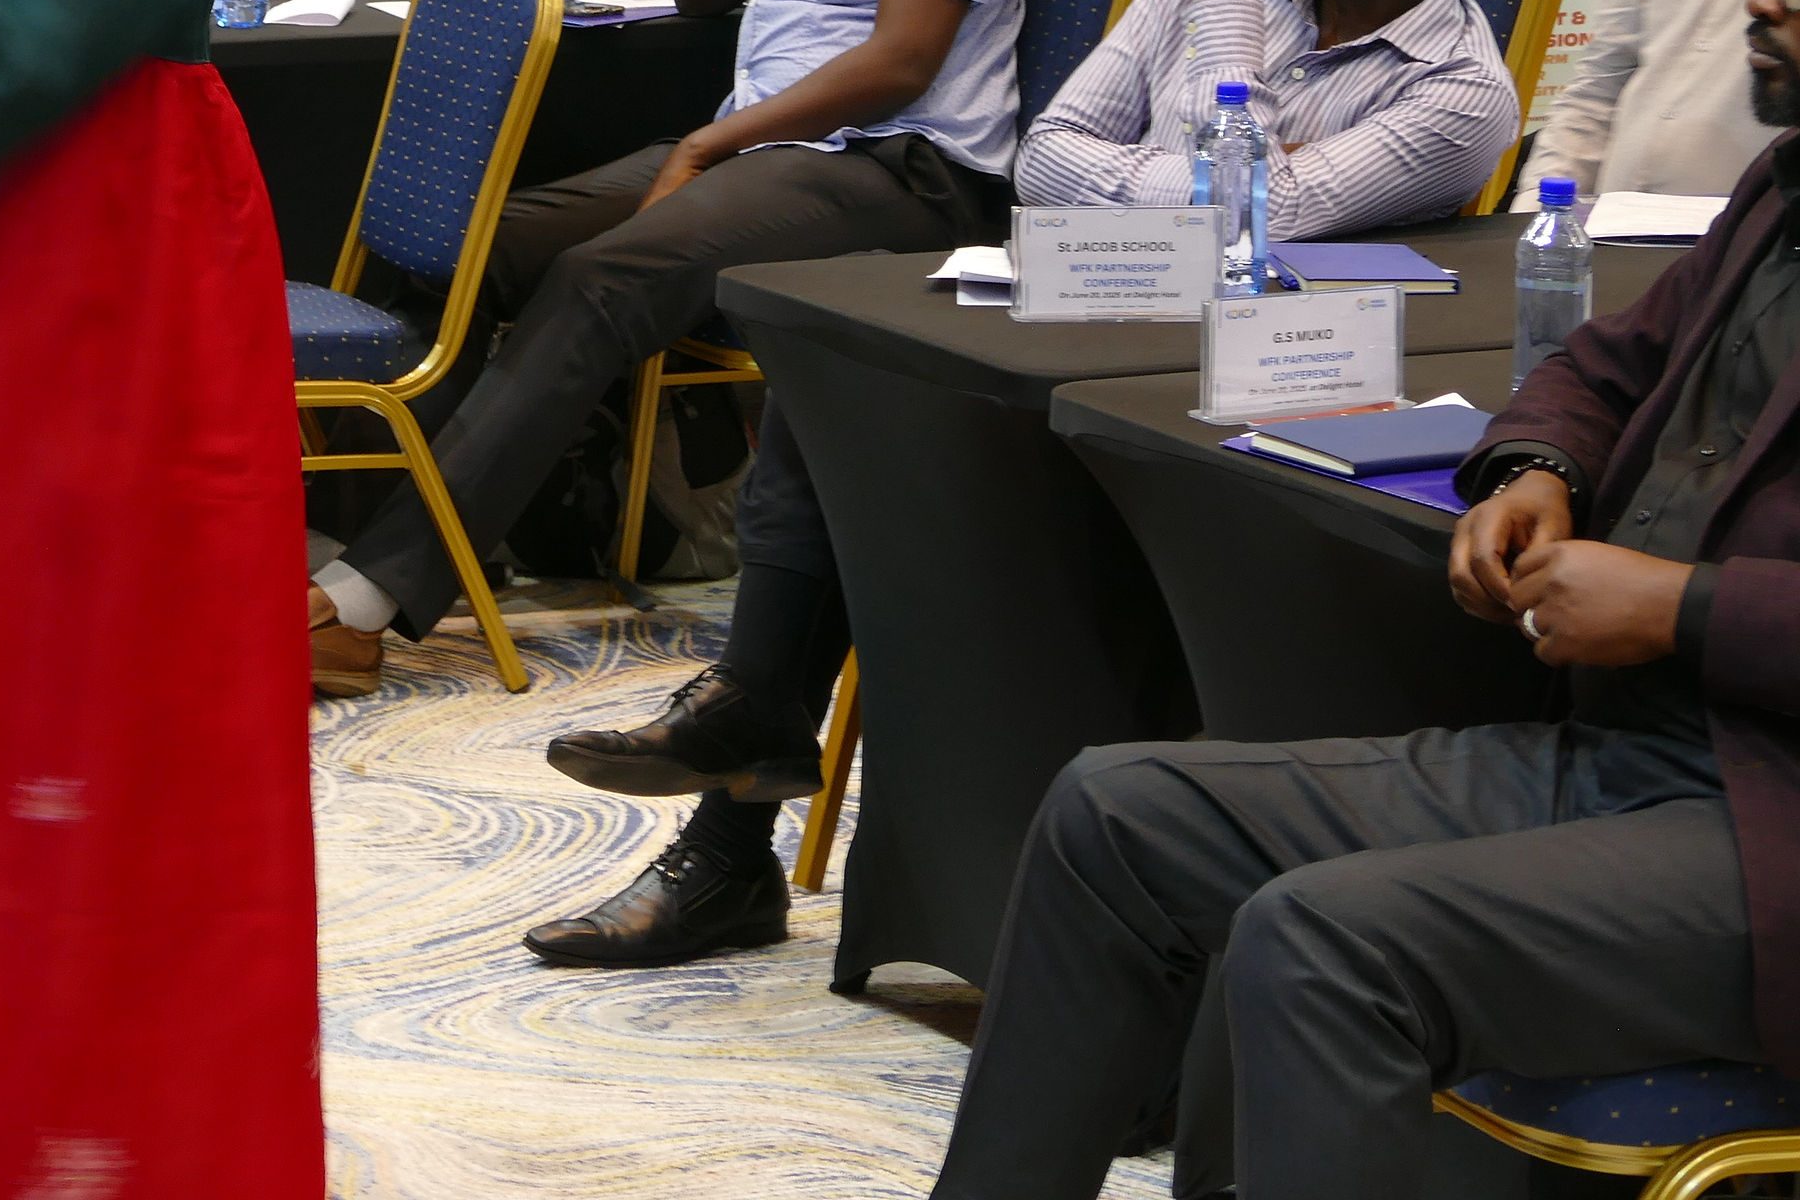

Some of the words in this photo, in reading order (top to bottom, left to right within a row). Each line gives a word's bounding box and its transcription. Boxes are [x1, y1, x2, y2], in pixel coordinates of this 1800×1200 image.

[1572, 11, 1587, 25] &
[1547, 33, 1594, 48] SION
[1057, 242, 1072, 253] St
[1075, 242, 1118, 253] JACOB
[1121, 241, 1176, 252] SCHOOL
[1069, 263, 1093, 273] WFK
[1095, 263, 1171, 273] PARTNERSHIP
[1083, 278, 1158, 288] CONFERENCE
[1272, 331, 1293, 344] G.S
[1295, 328, 1334, 342] MUKO
[1283, 351, 1356, 366] PARTNERSHIP
[1271, 368, 1342, 382] CONFERENCE
